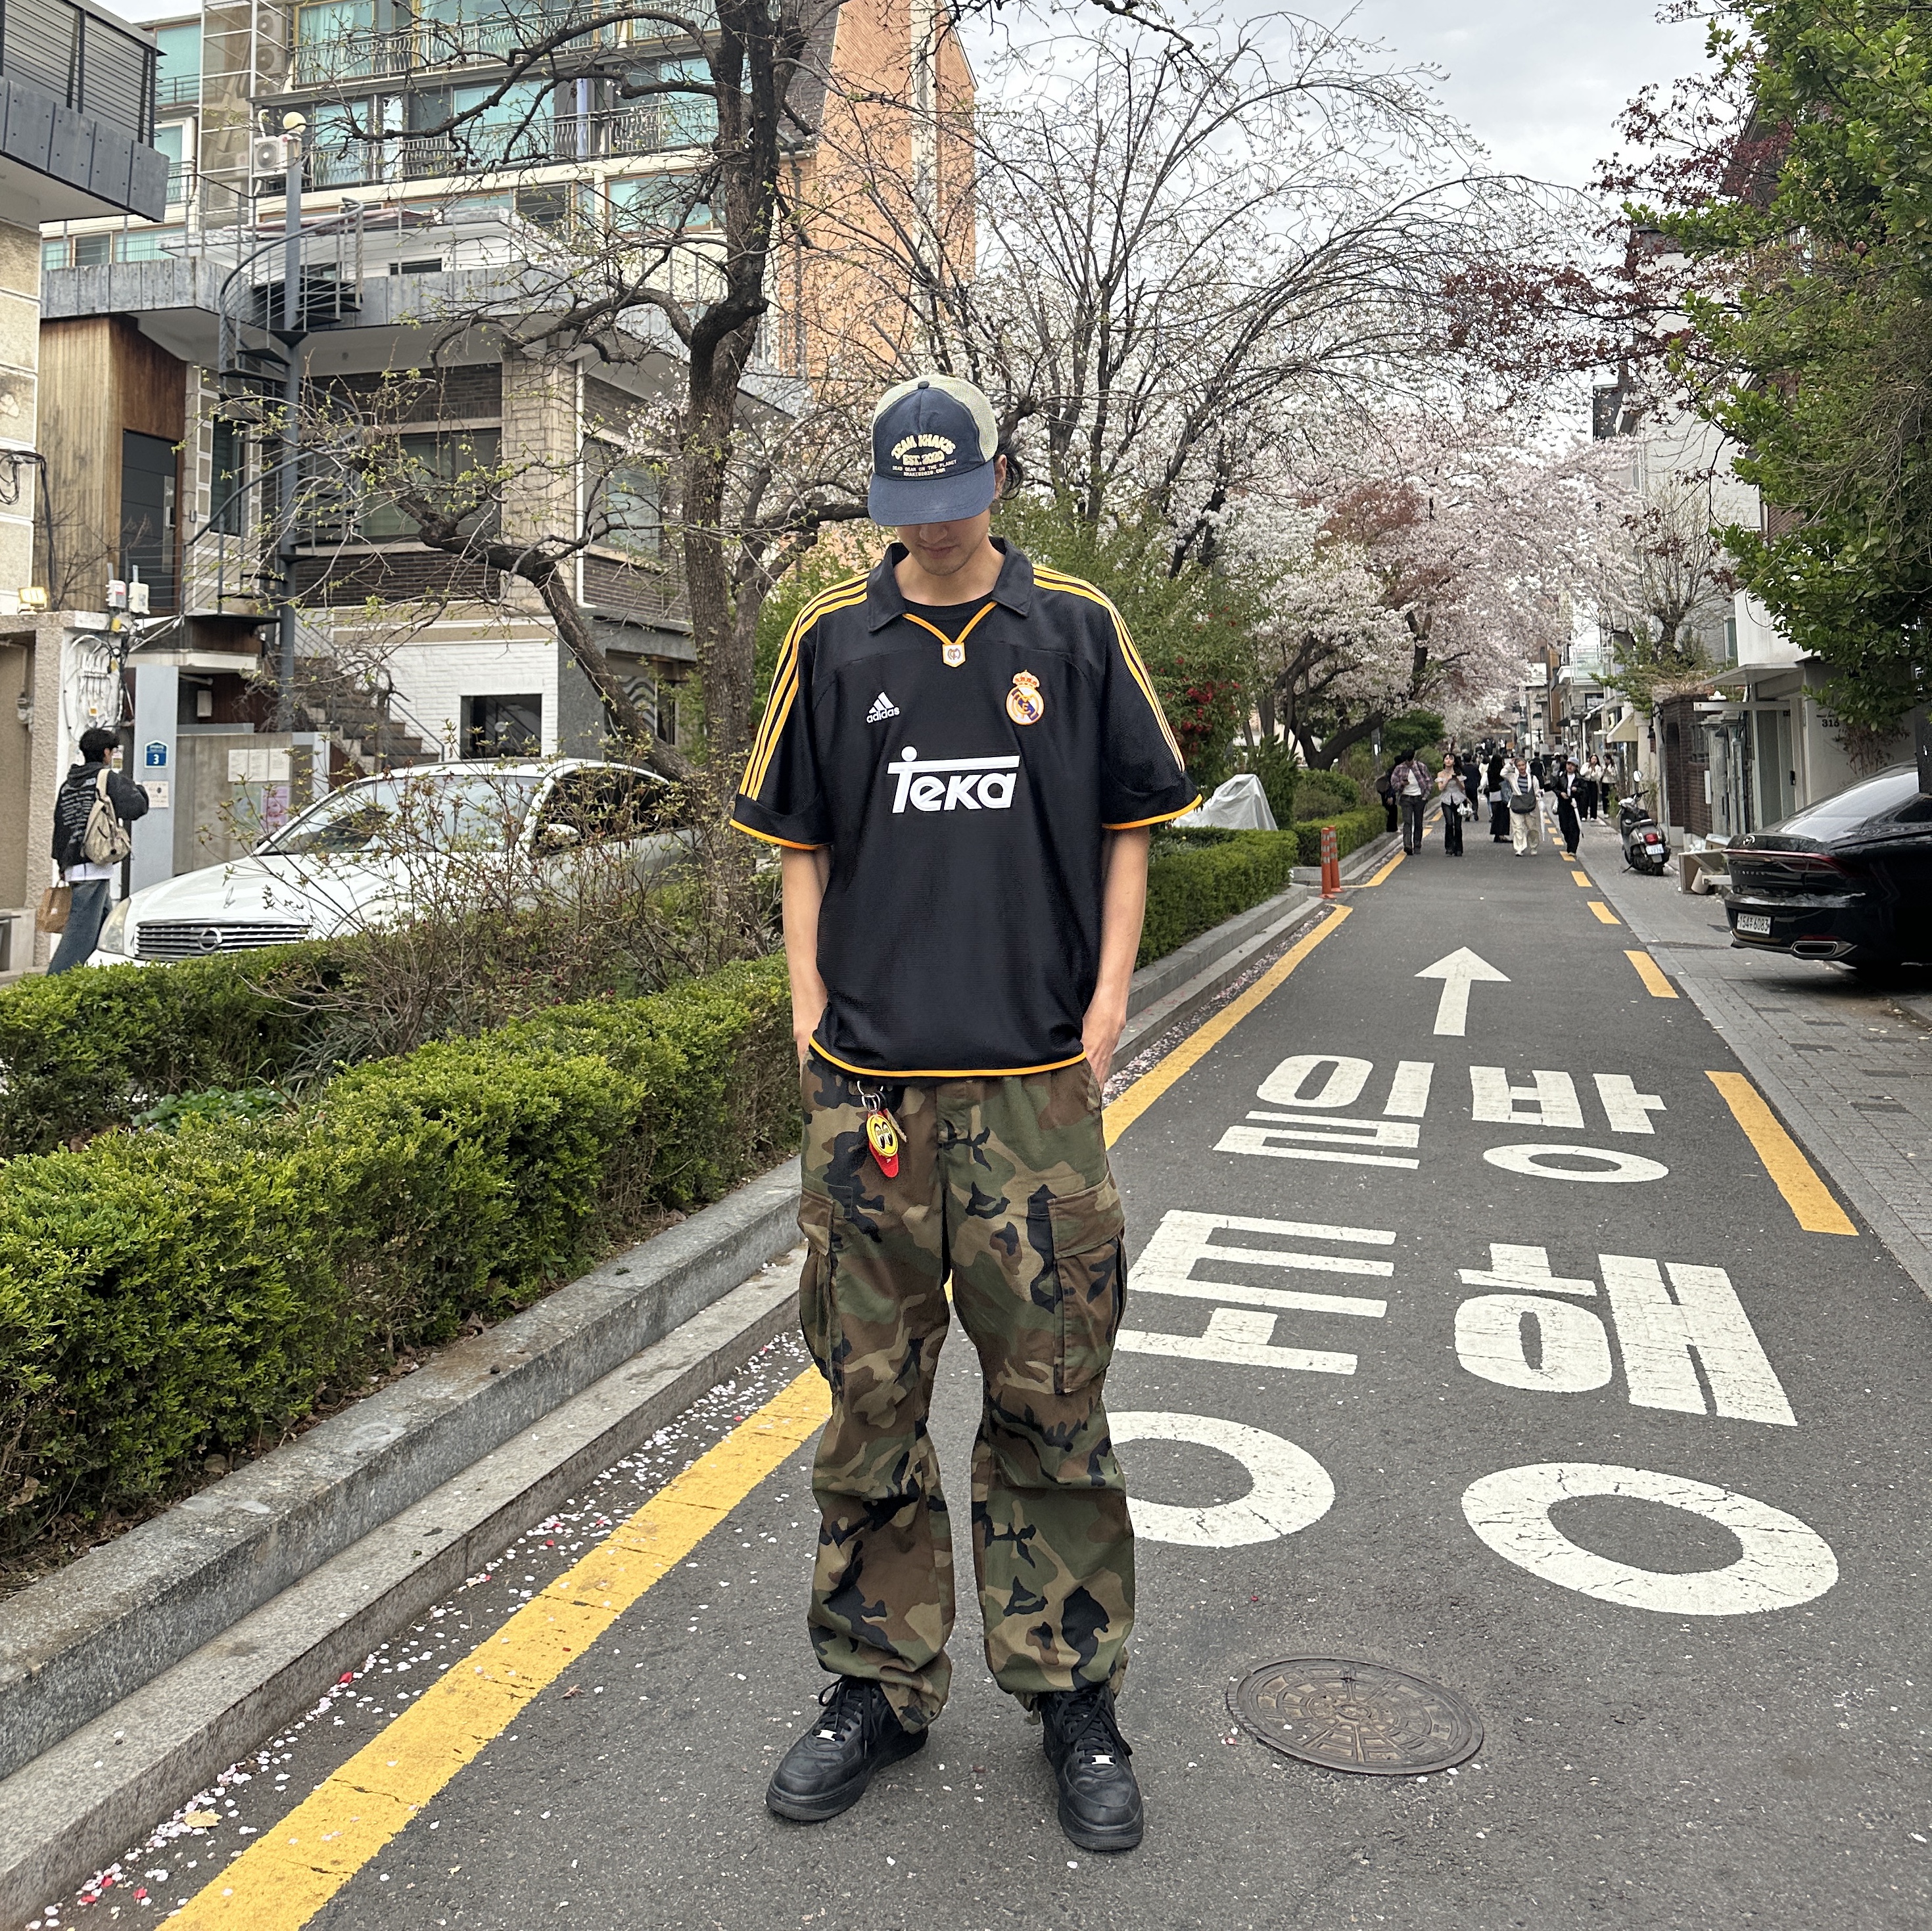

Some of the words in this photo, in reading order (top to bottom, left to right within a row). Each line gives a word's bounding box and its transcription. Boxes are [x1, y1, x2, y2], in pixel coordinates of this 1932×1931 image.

[891, 435, 917, 459] TEAM
[866, 707, 901, 724] adidas
[153, 754, 160, 765] 3
[1212, 1053, 1670, 1184] 일방
[1107, 1209, 1840, 1616] 통행
